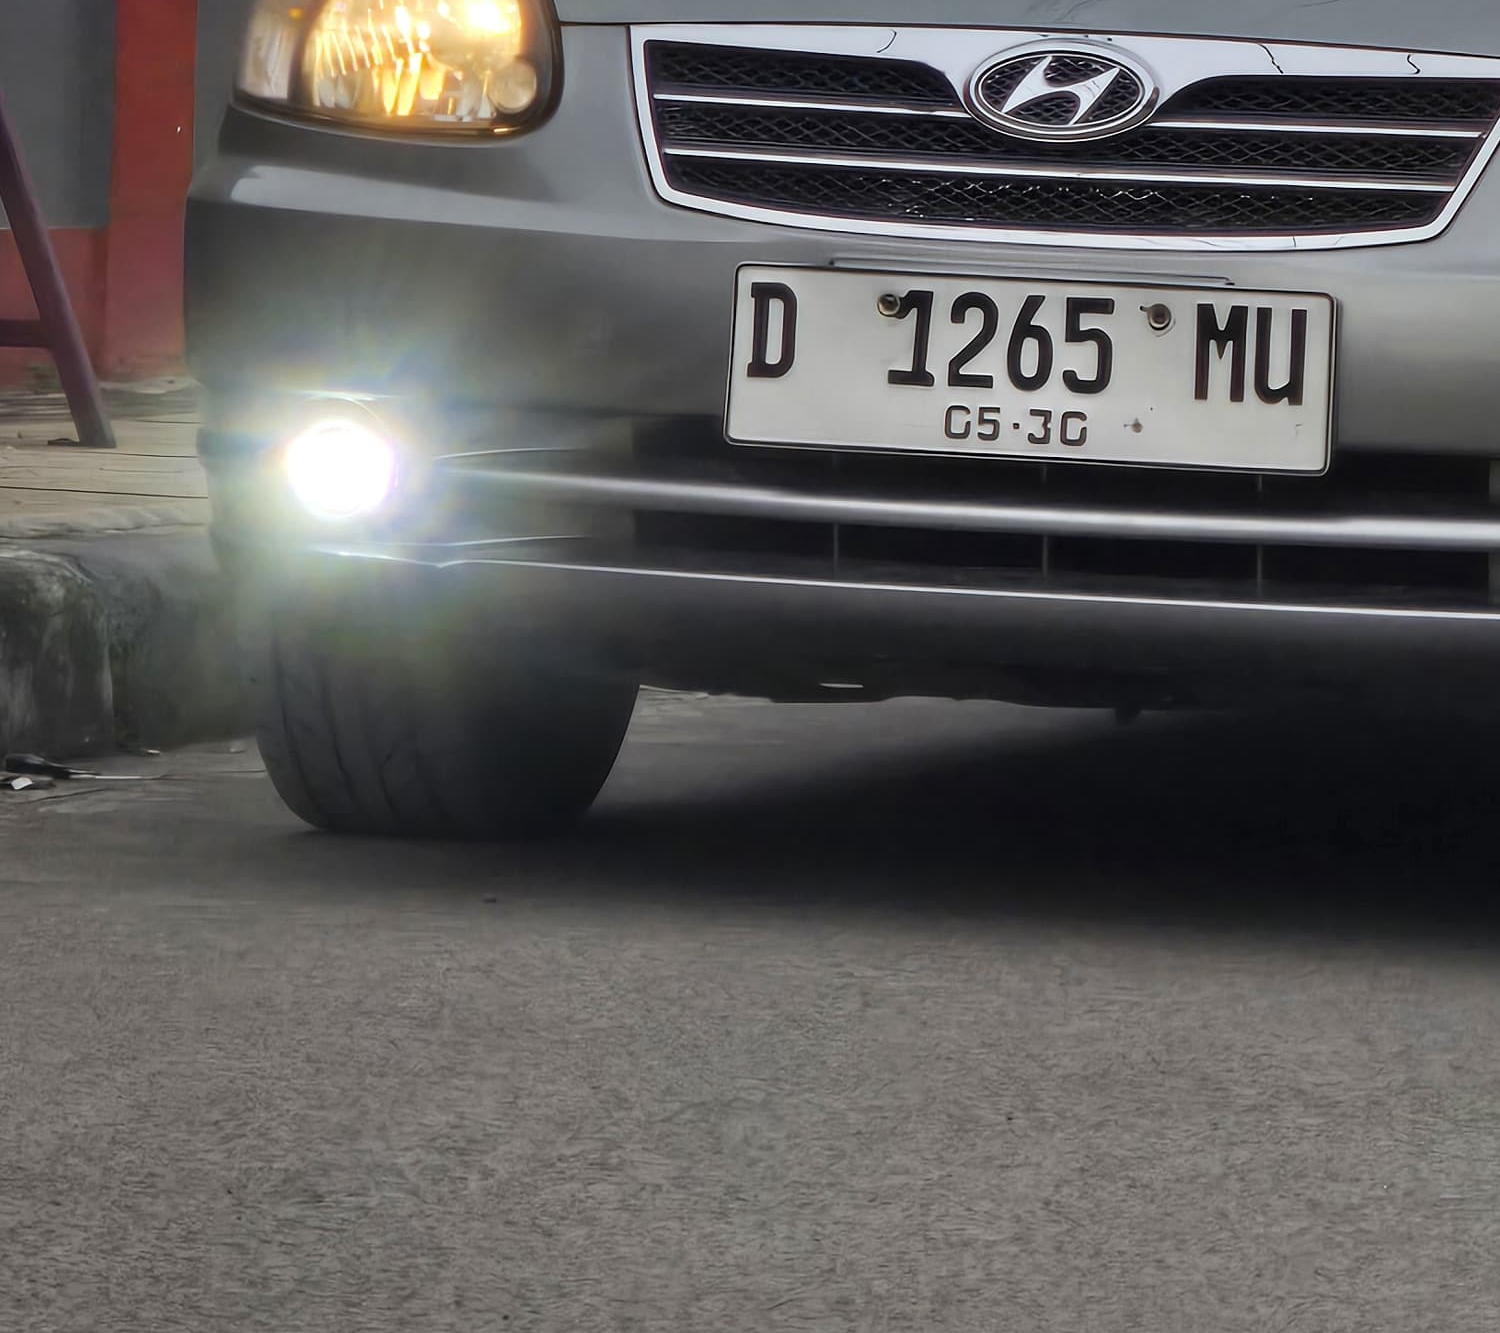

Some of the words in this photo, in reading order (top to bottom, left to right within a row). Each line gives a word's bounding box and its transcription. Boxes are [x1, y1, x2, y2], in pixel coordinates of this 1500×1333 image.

[746, 281, 798, 379] D
[887, 289, 1115, 395] 1265
[1193, 302, 1308, 407] MU
